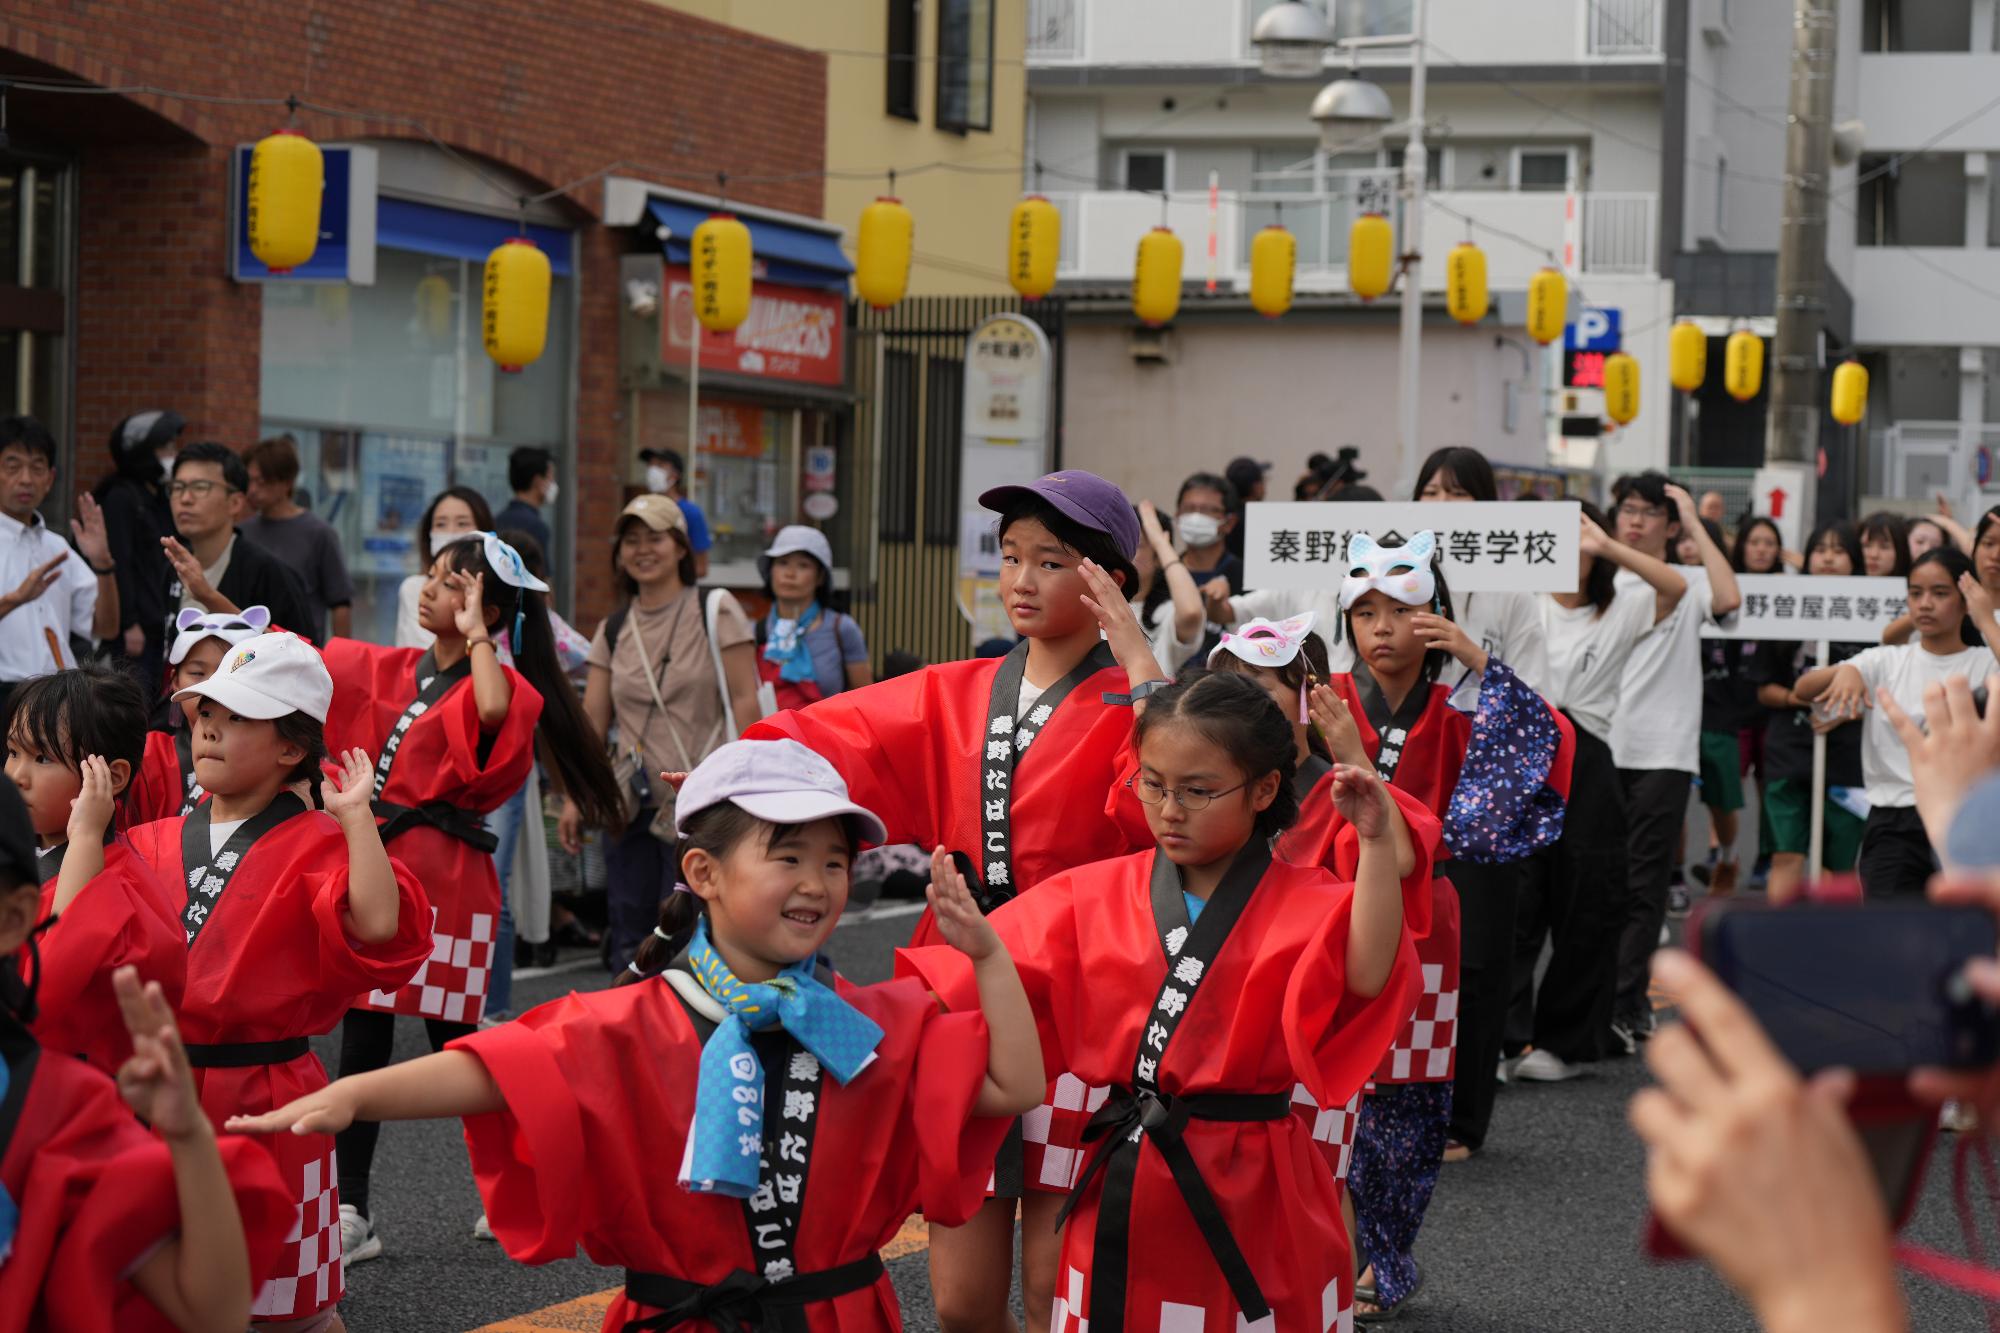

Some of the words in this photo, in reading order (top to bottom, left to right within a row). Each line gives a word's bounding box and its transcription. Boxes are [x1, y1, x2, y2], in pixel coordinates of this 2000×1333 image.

[985, 714, 1014, 886] 秦野たばこ祭
[1136, 956, 1205, 1098] 秦野たば
[775, 1050, 821, 1227] 秦野たば
[749, 1158, 794, 1285] ばこ祭
